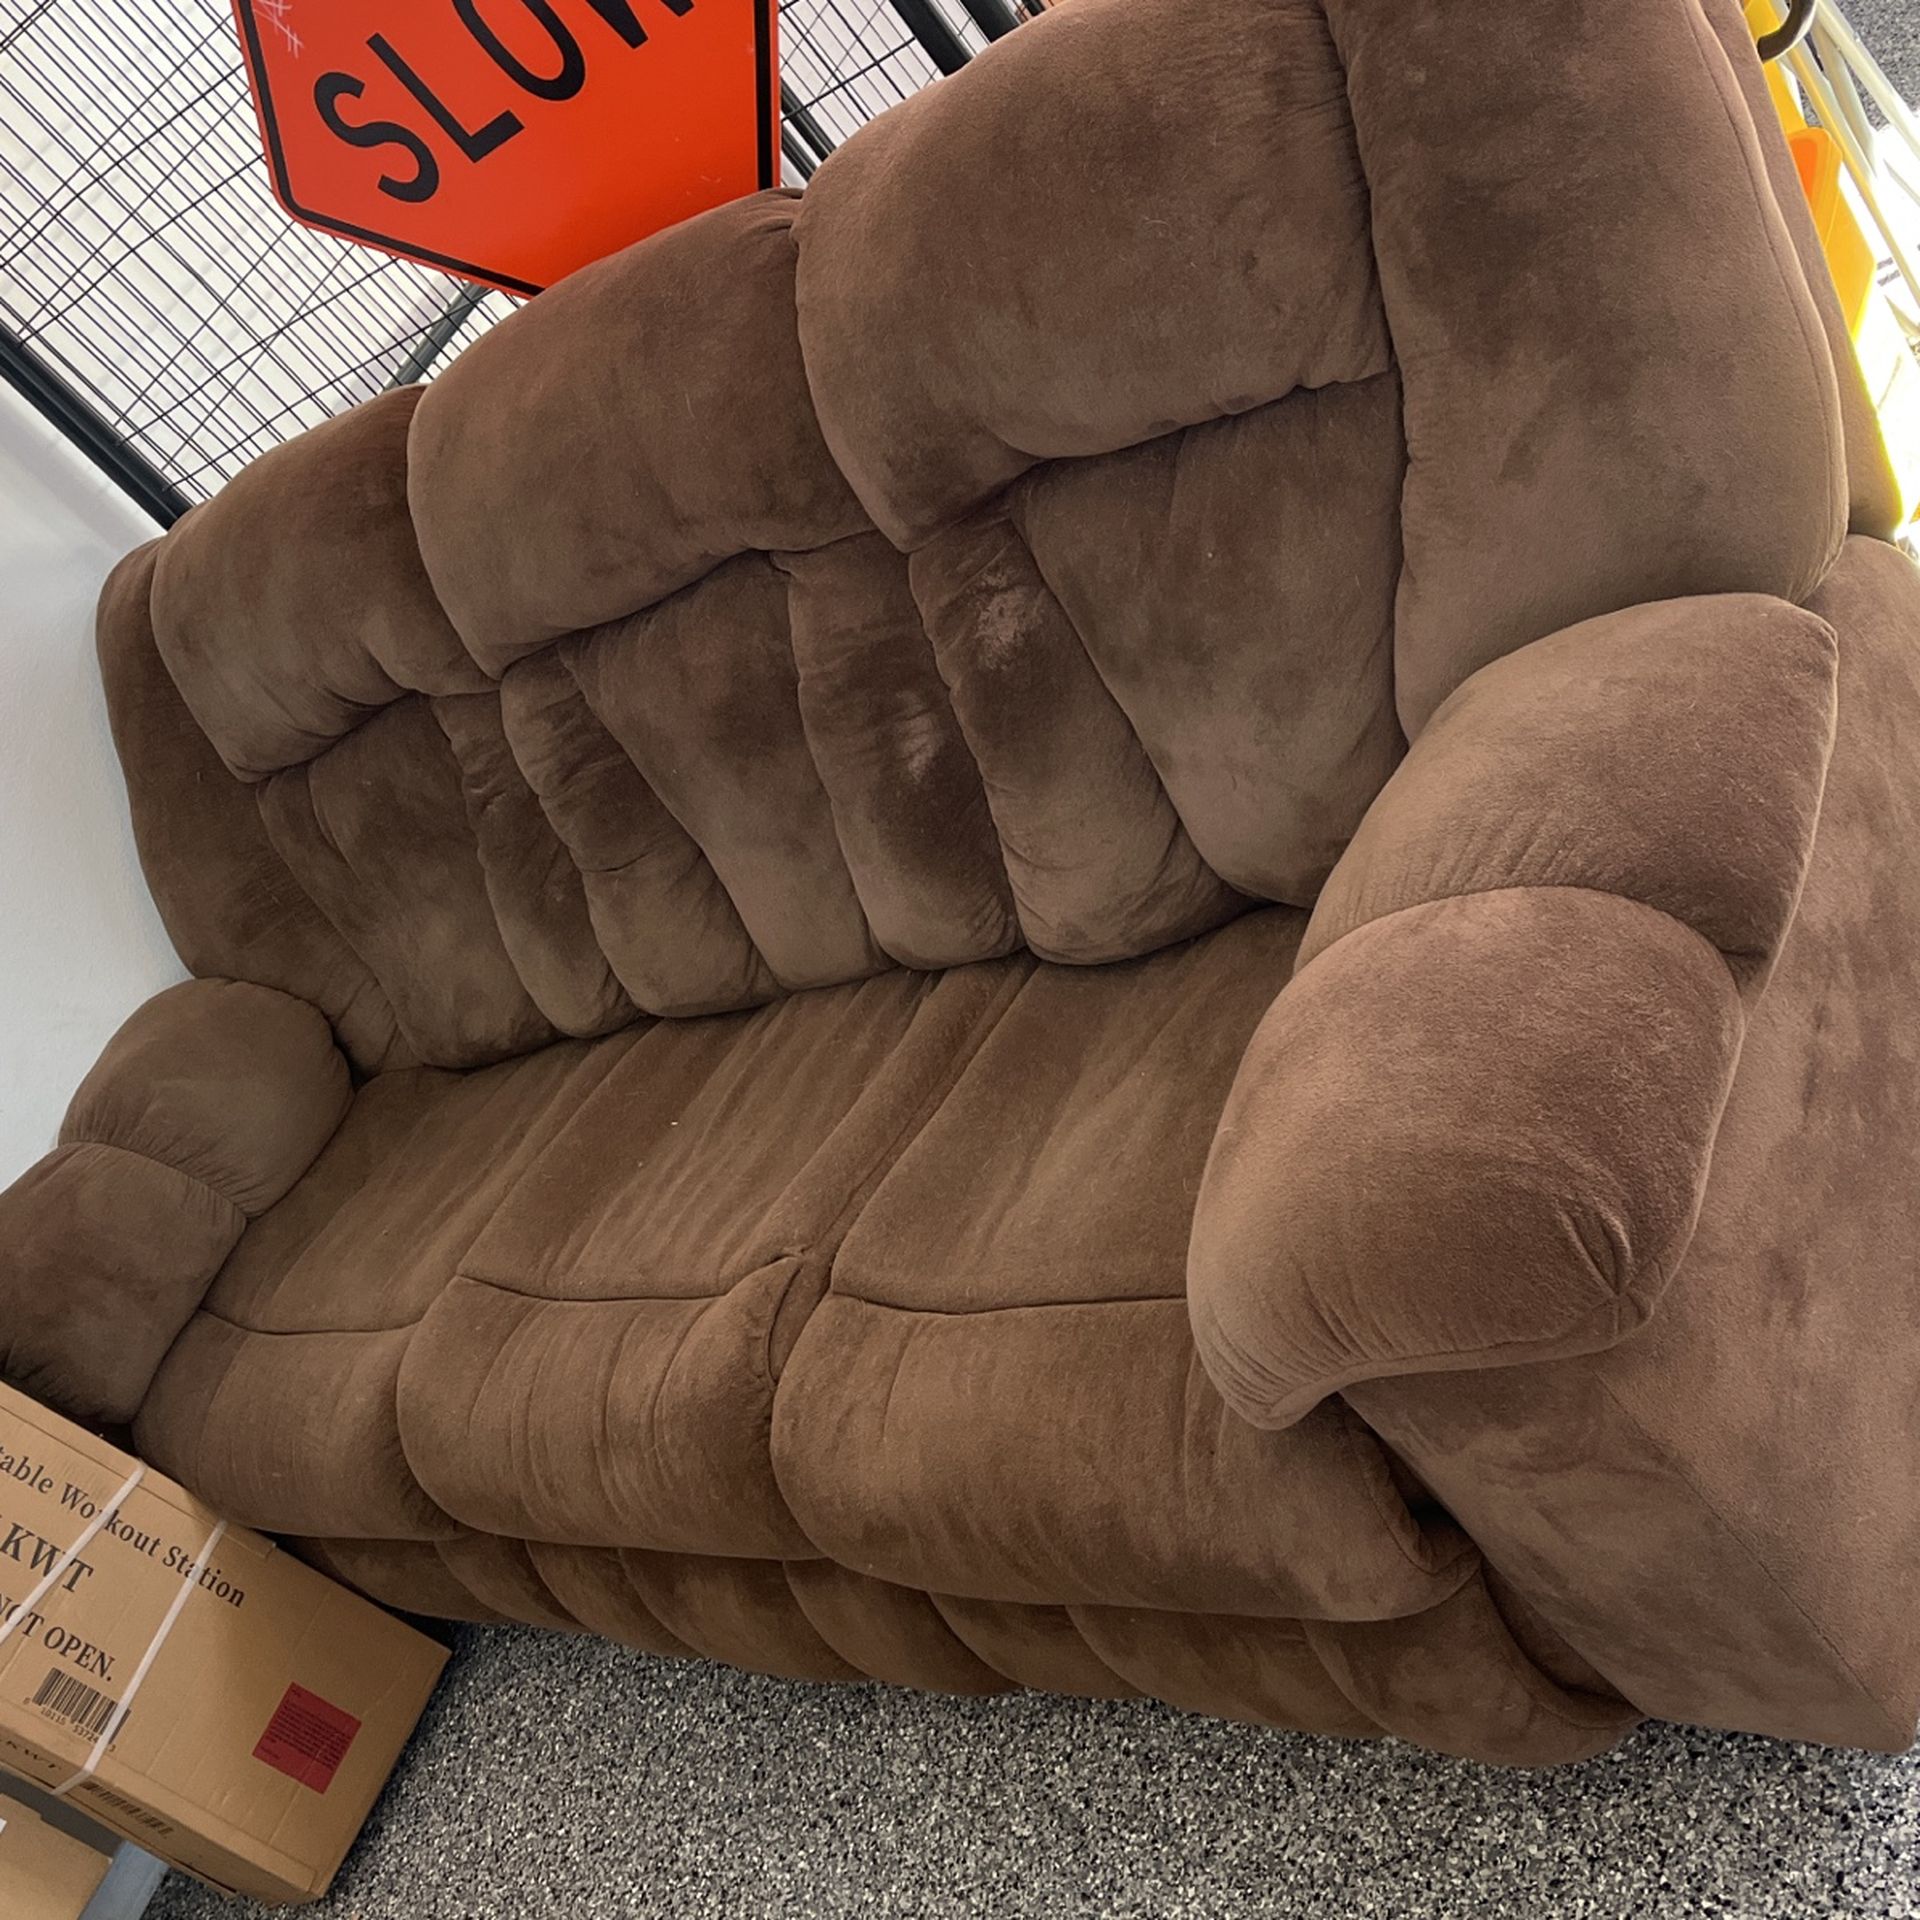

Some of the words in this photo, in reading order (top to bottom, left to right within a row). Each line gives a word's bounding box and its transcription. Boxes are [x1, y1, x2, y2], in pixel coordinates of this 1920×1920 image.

[0, 1446, 54, 1494] able
[60, 1482, 161, 1557] Wokout
[44, 1626, 116, 1682] OPEN.
